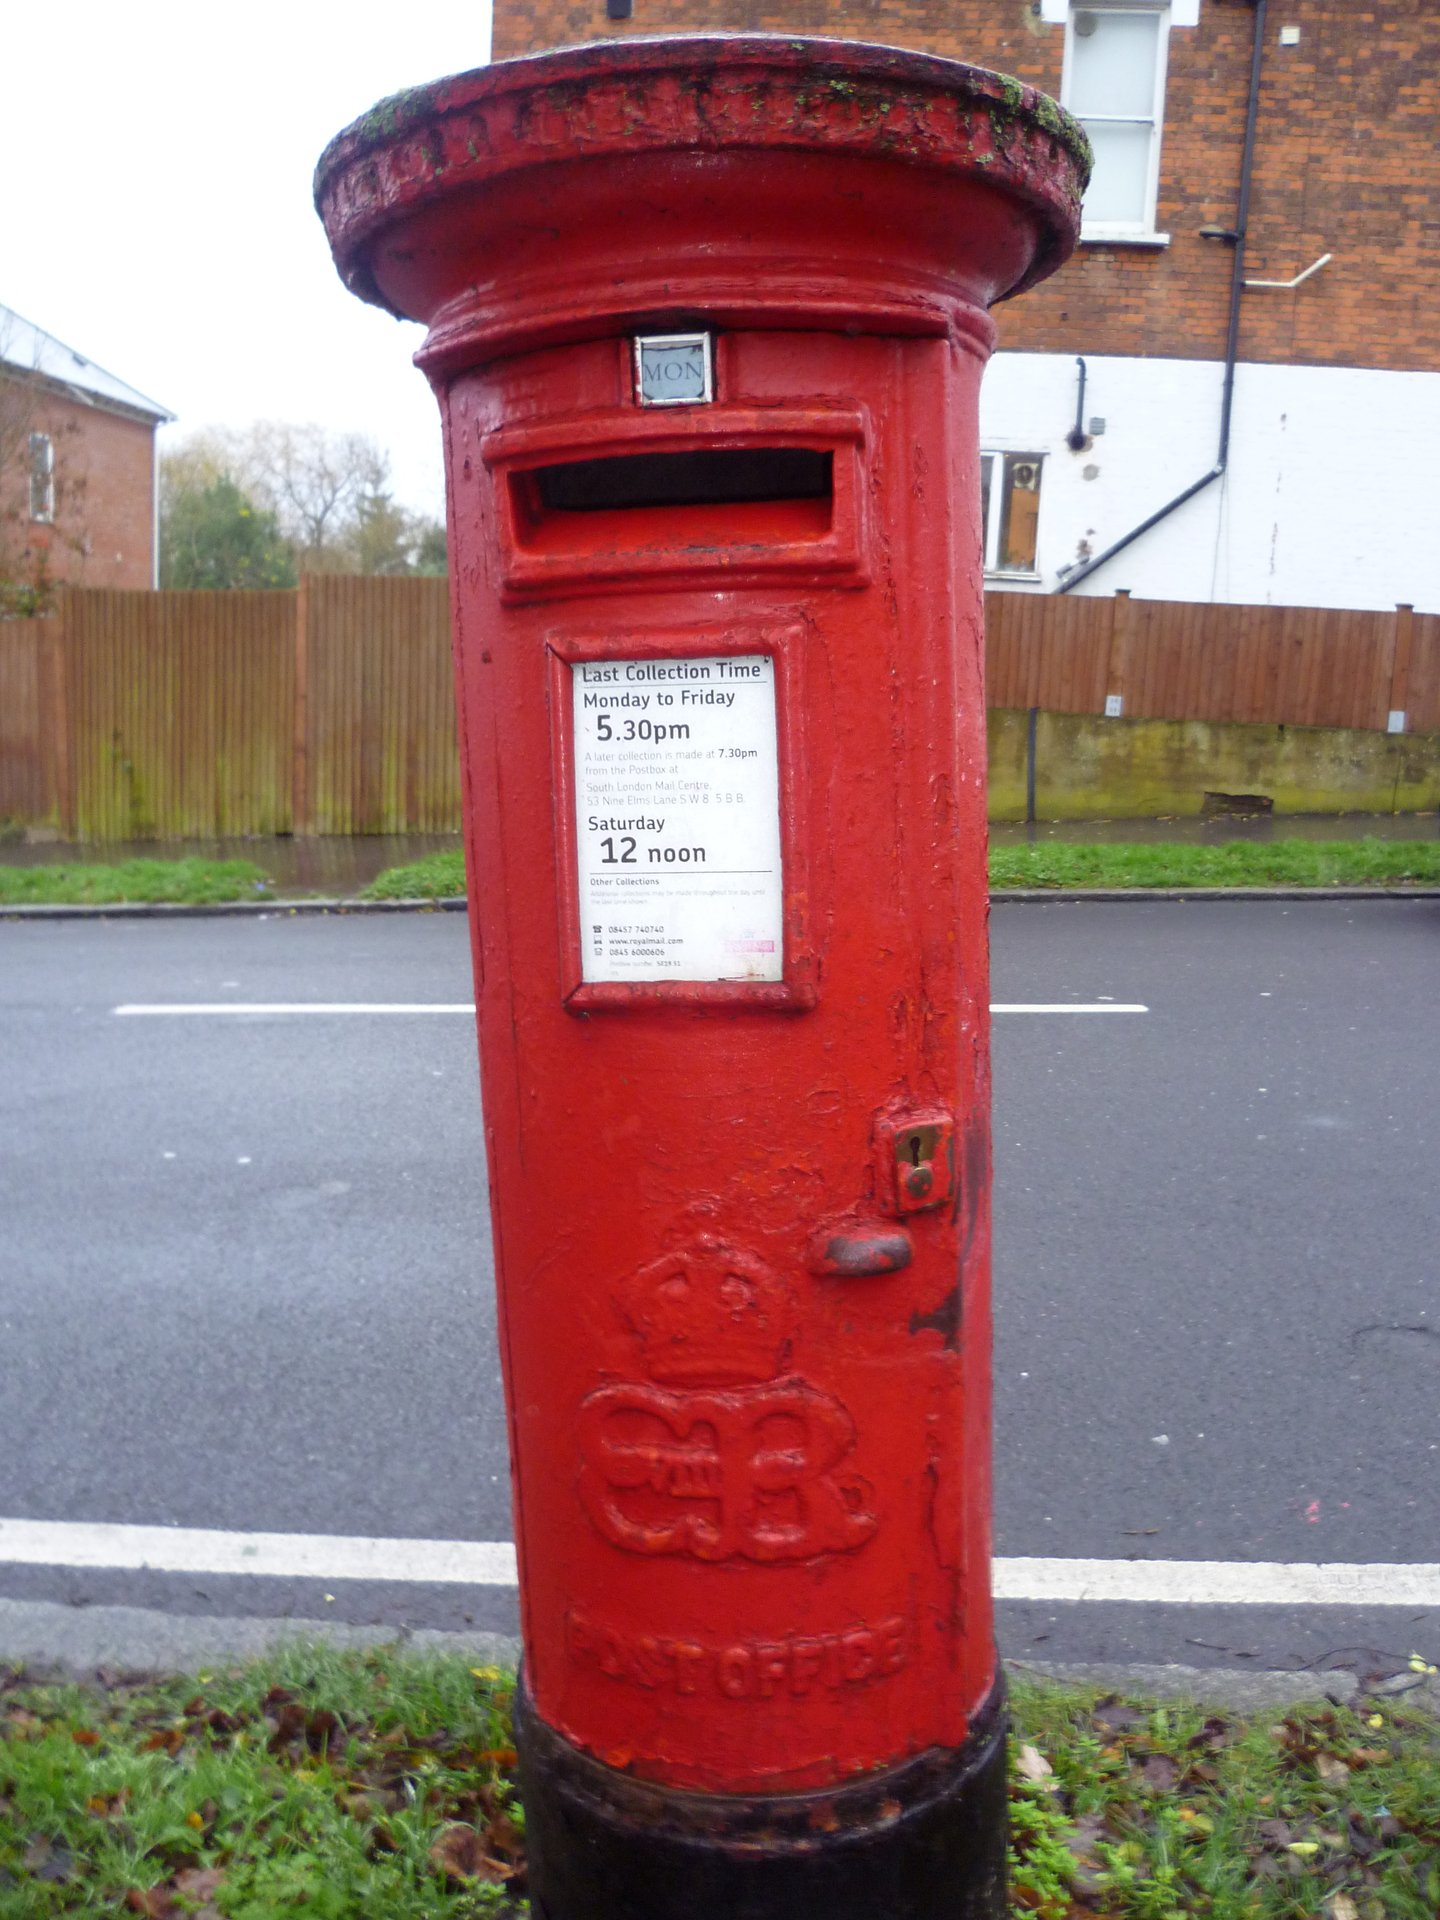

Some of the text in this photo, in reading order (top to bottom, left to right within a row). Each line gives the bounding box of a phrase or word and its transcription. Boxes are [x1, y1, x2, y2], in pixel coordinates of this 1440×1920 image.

[643, 361, 704, 382] MON
[583, 661, 761, 682] Last Collection Time
[584, 689, 735, 710] Monday to Friday
[597, 714, 690, 745] 5.30pm
[585, 748, 758, 761] A later collection is made at 7.30pm
[585, 764, 679, 776] from the Postbox at
[586, 782, 614, 792] South
[617, 781, 652, 792] London
[655, 780, 675, 791] Mail
[587, 796, 599, 806] 53
[602, 795, 625, 806] Nine
[627, 795, 650, 806] Elms
[653, 795, 677, 805] Lane
[588, 815, 665, 833] Saturday
[600, 836, 706, 864] 12 noon
[590, 877, 660, 886] Other Collections
[609, 937, 684, 945] www.royalmail.com
[717, 1612, 905, 1702] OFFICE
